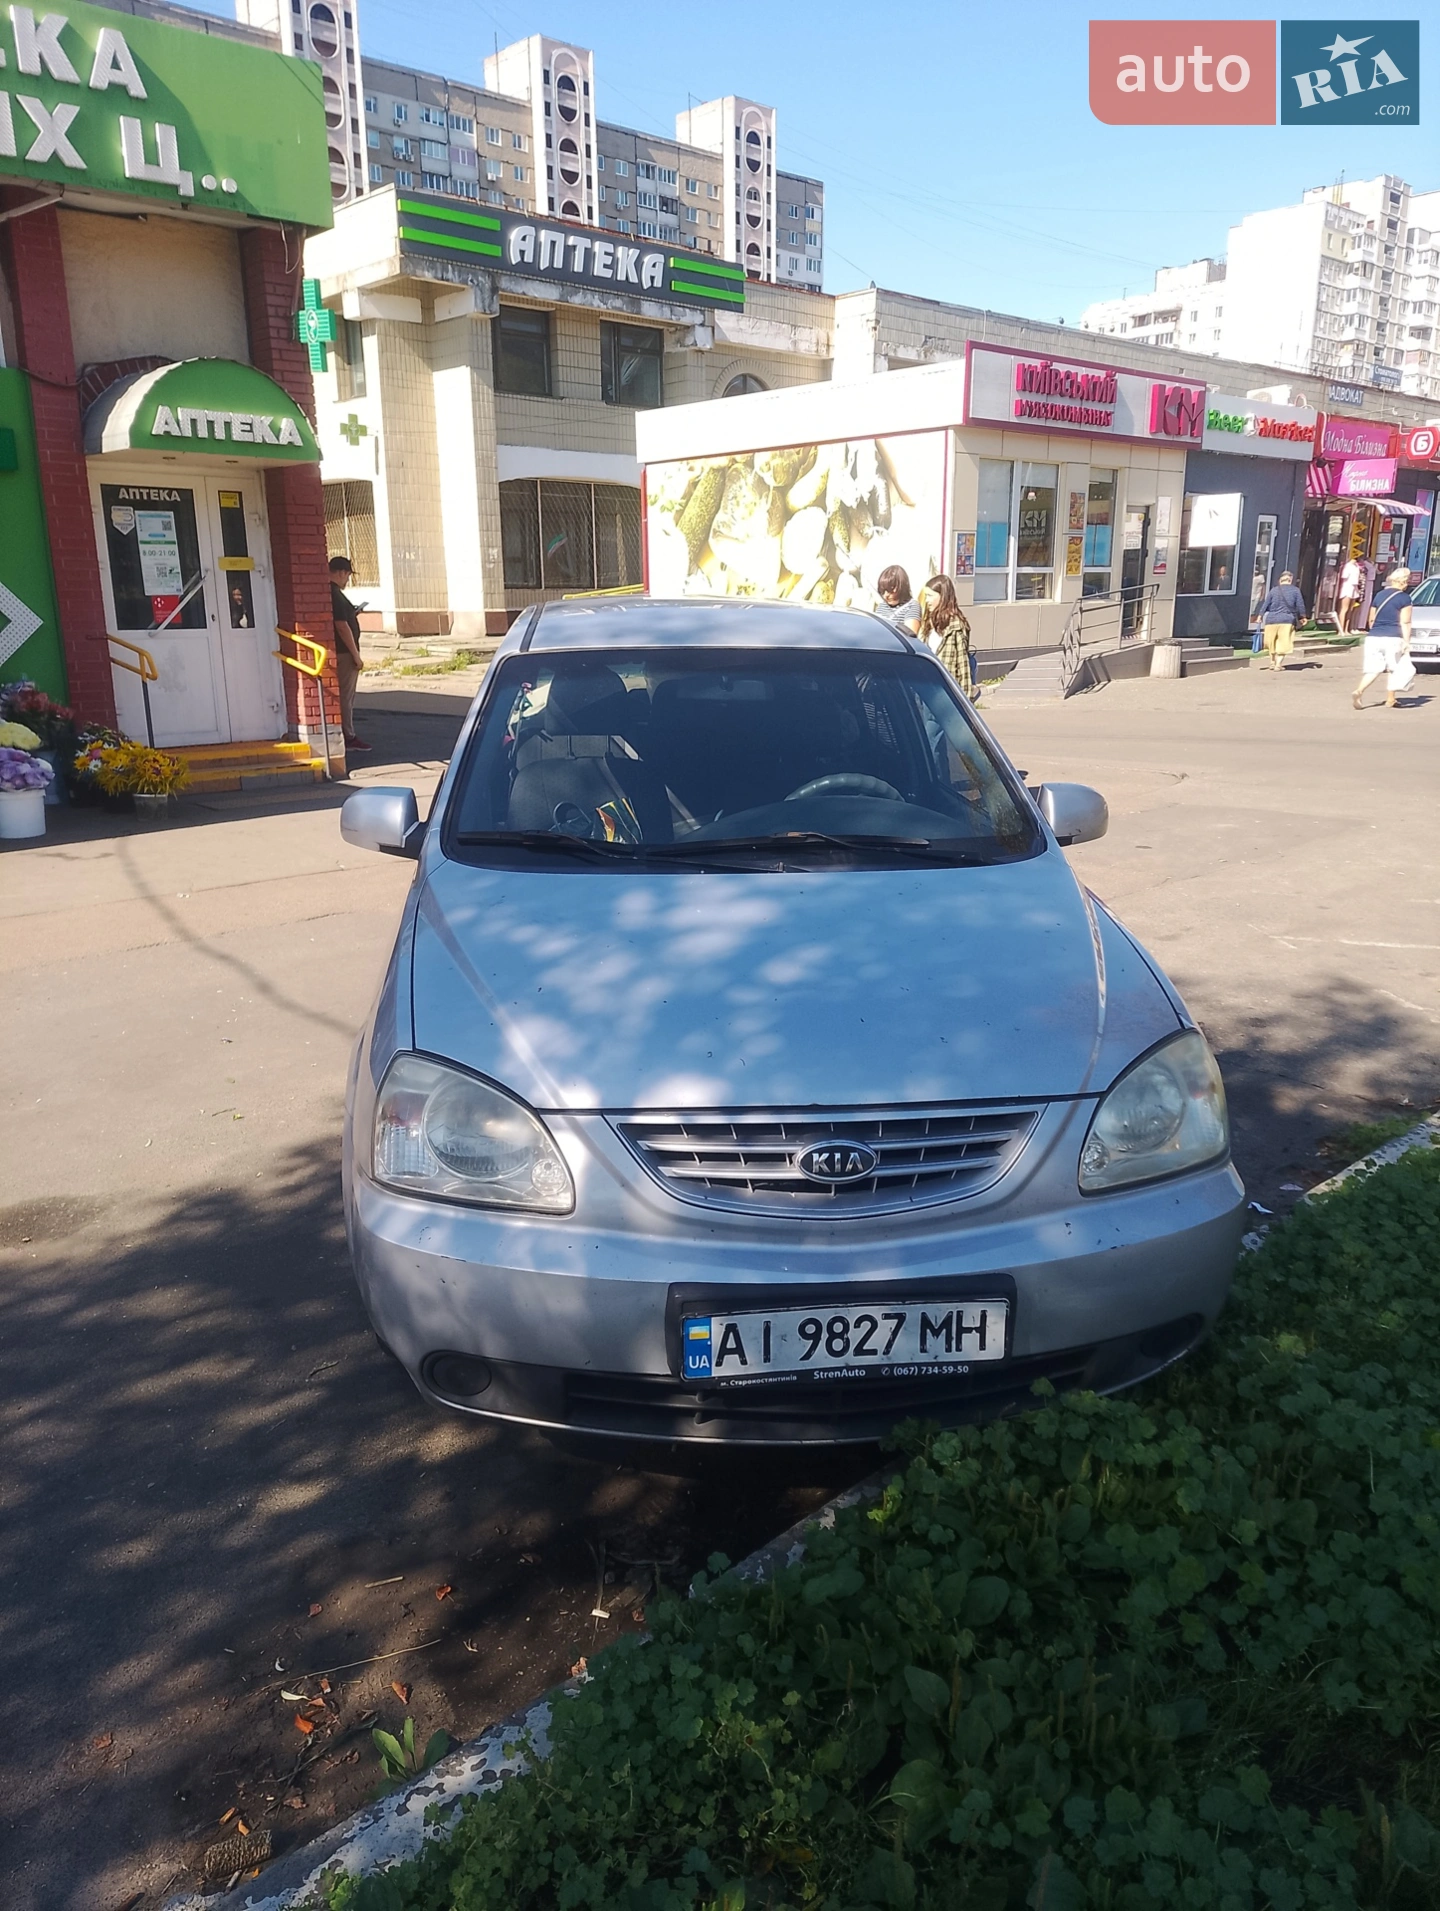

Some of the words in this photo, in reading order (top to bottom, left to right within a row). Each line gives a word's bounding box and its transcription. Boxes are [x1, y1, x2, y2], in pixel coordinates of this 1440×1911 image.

[0, 4, 148, 99] КА
[509, 225, 666, 290] АПТЕКА
[1016, 361, 1118, 404] КИЇВСЬКИЙ
[1330, 385, 1364, 404] АДВОКАТ
[151, 404, 304, 447] АПТЕКА
[1207, 409, 1247, 433] Beer
[1325, 429, 1353, 453] Модна
[1354, 434, 1388, 457] Білизна
[118, 487, 181, 502] АПТЕКА
[1350, 479, 1390, 492] БІЛИЗНА
[812, 1152, 864, 1173] KIA
[715, 1320, 772, 1367] AI
[797, 1312, 907, 1361] 9827
[919, 1309, 988, 1354] MH
[689, 1354, 710, 1370] UA
[813, 1367, 866, 1379] StrenAuto
[893, 1365, 918, 1377] (067)
[921, 1365, 969, 1375] 734-59-50
